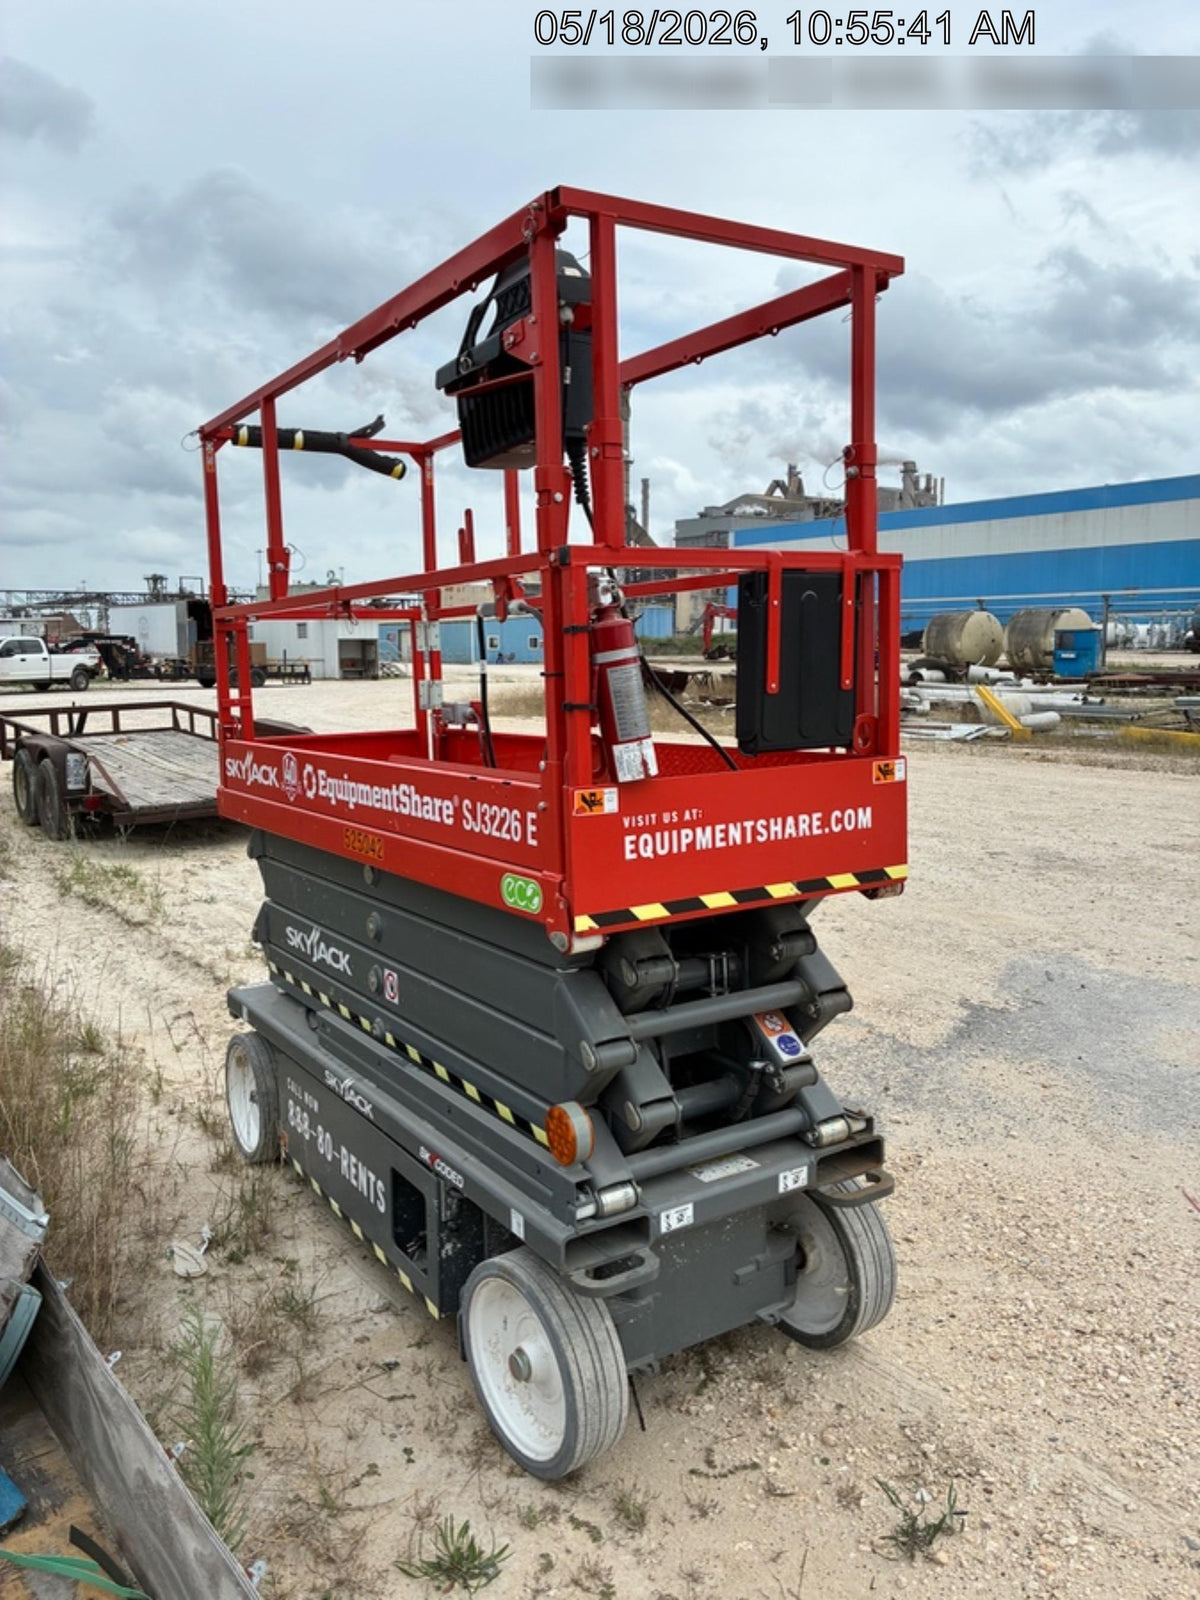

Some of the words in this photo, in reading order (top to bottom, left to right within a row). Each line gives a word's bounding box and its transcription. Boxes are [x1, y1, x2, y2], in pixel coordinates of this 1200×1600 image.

[226, 752, 280, 789] SKYJACK
[462, 798, 521, 842] SJ3226
[526, 811, 538, 847] E
[622, 812, 657, 829] VISIT
[663, 811, 678, 823] US
[683, 808, 703, 822] AT:
[624, 806, 873, 861] EQUIPMENTSHARE.COM
[344, 827, 384, 860] 525042
[285, 925, 353, 977] SKYJACK
[324, 1069, 374, 1120] SKYJACK
